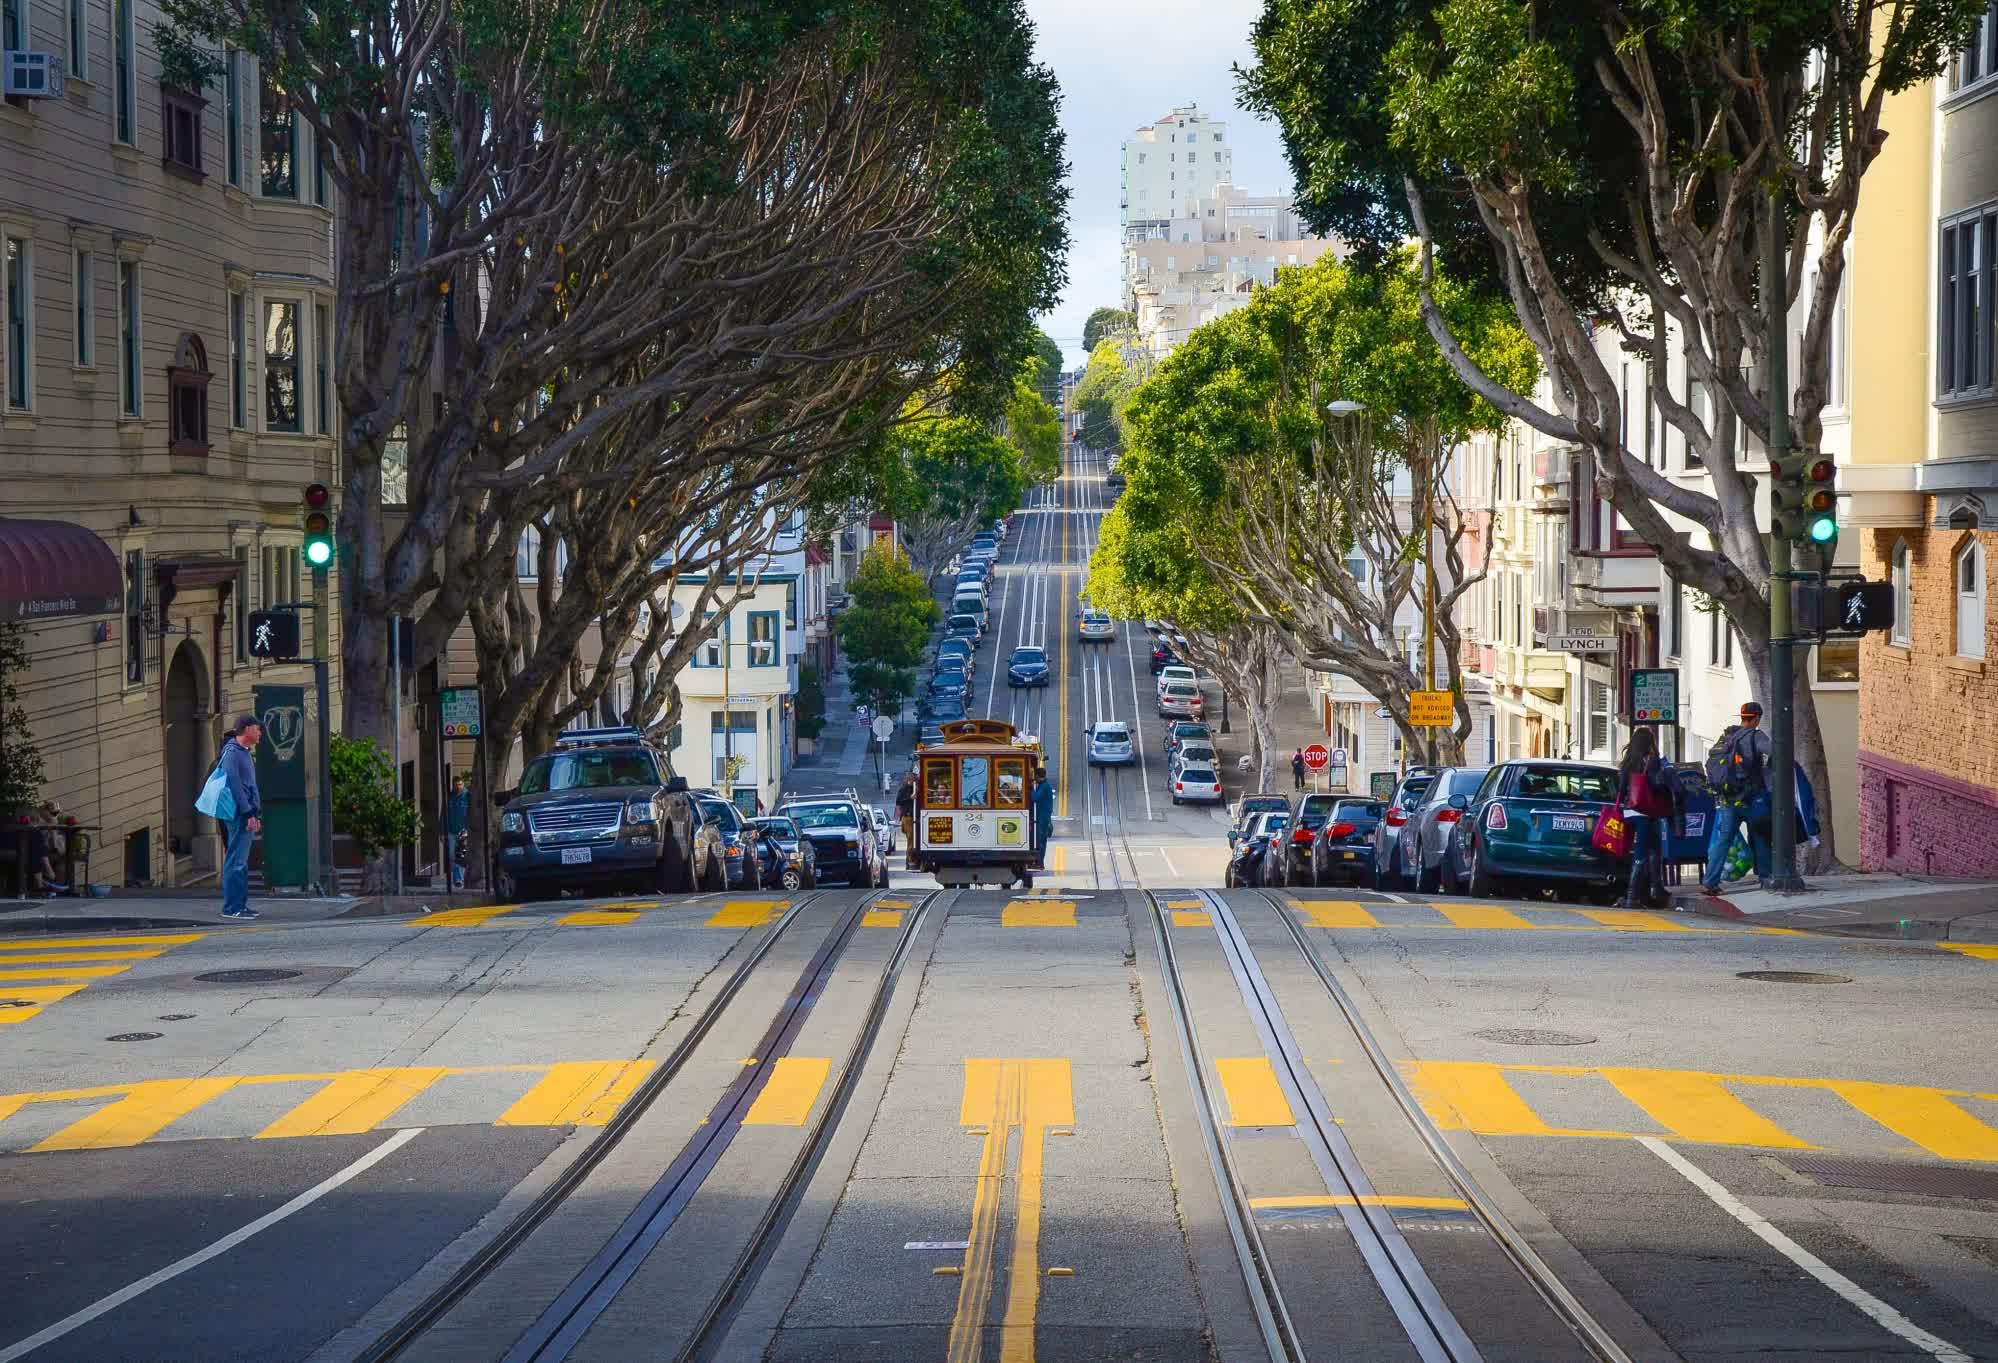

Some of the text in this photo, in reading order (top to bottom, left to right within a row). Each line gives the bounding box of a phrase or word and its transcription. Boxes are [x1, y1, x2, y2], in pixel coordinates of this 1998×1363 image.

[1560, 639, 1605, 649] LYNCH
[1636, 674, 1645, 685] 2
[1305, 751, 1327, 761] STOP
[965, 812, 985, 822] 24
